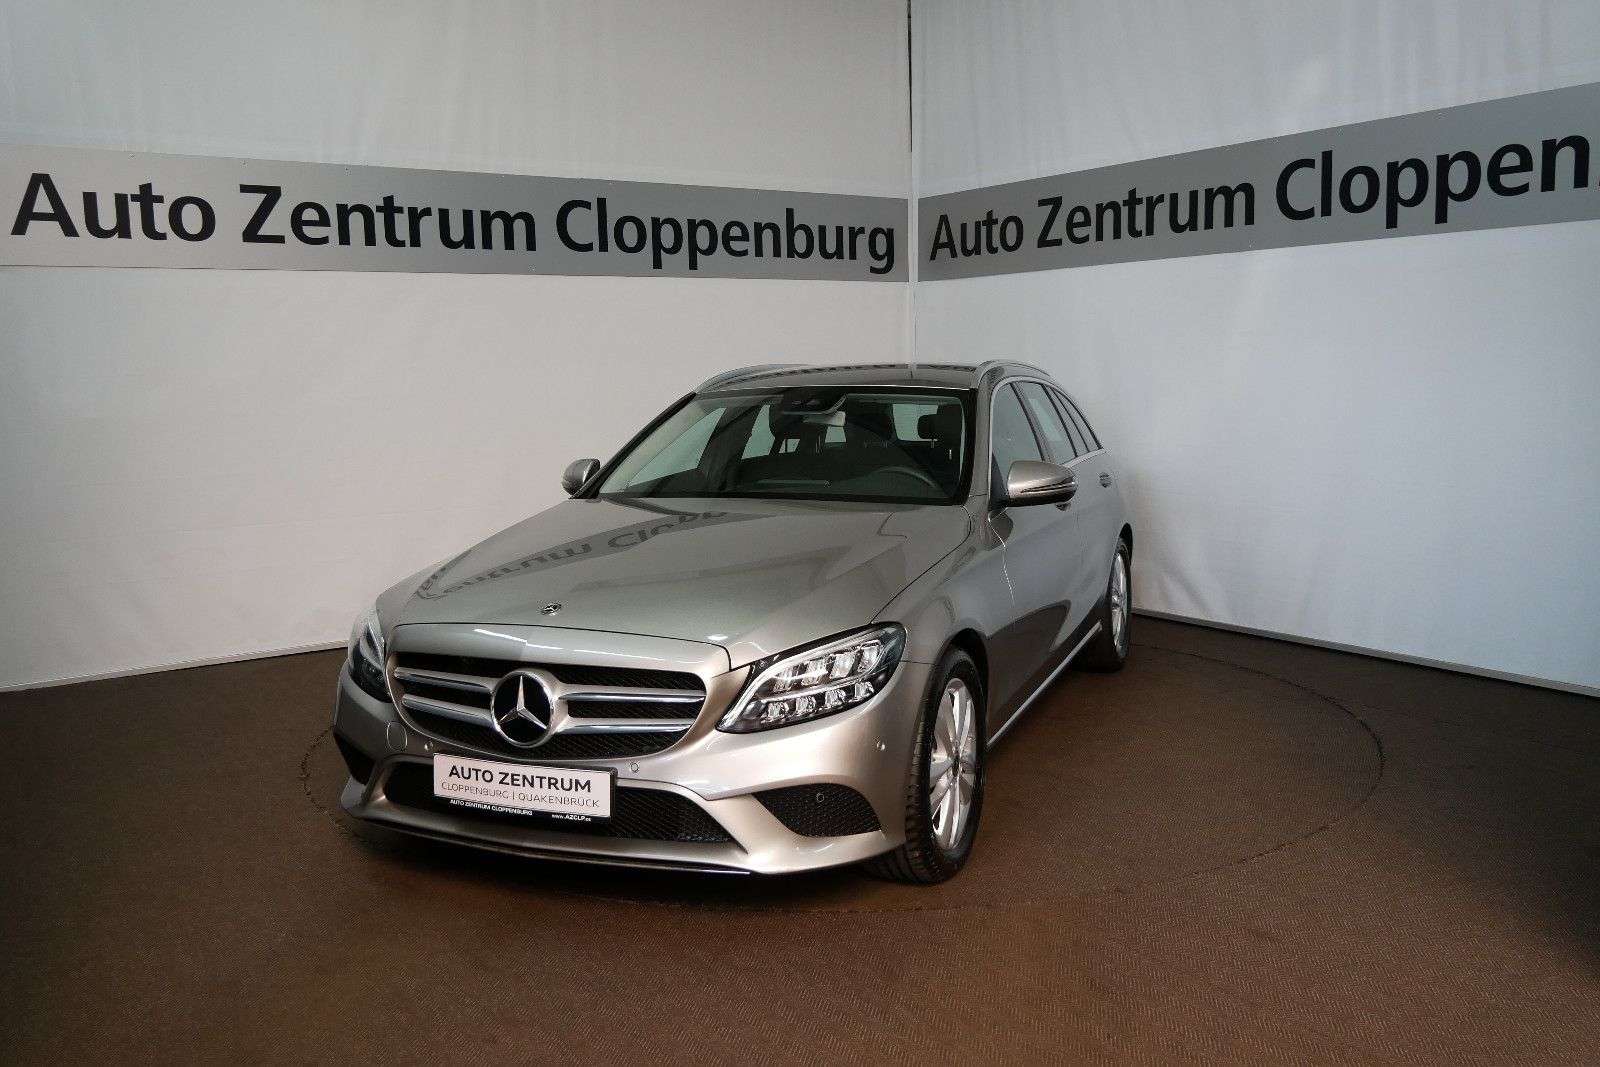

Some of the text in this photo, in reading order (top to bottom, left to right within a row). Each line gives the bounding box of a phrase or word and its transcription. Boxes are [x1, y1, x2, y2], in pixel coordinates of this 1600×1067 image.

[10, 172, 896, 275] Auto Zentrum Cloppenburg
[929, 134, 1600, 261] Auto Zentrum Cloppen
[441, 781, 509, 799] CLOPPENBURG
[448, 764, 591, 793] AUTO ZENTRUM
